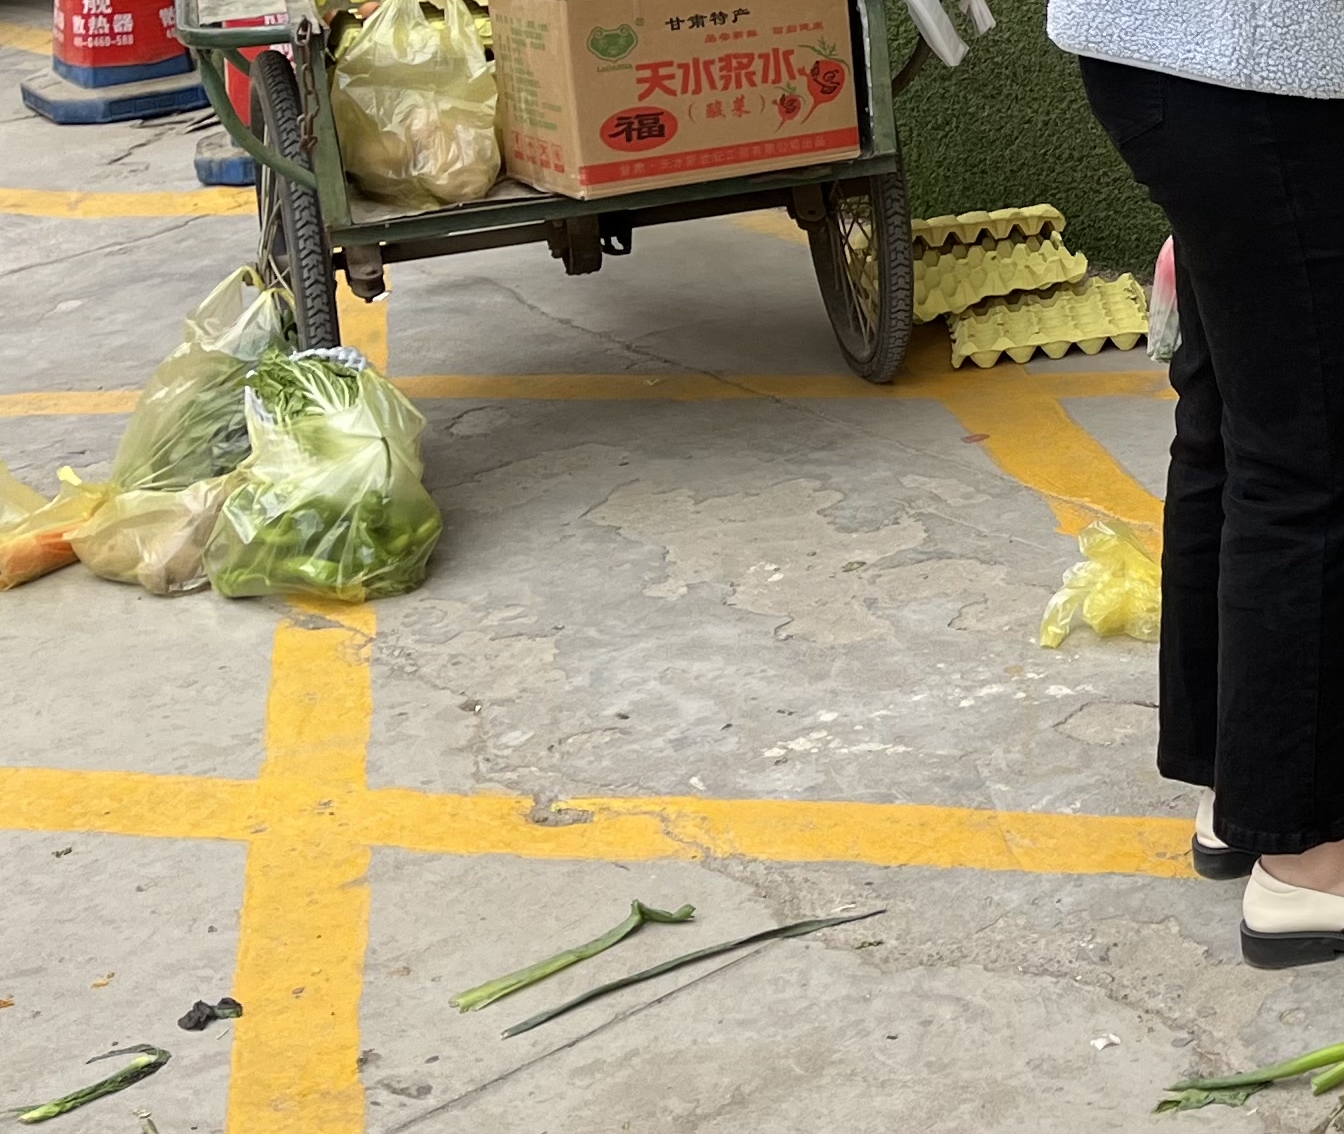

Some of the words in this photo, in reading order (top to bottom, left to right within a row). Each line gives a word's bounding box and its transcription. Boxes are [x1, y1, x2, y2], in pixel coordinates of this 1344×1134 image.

[665, 8, 750, 31] 甘肃特产
[635, 47, 797, 102] 天水浆水
[608, 112, 665, 143] 福
